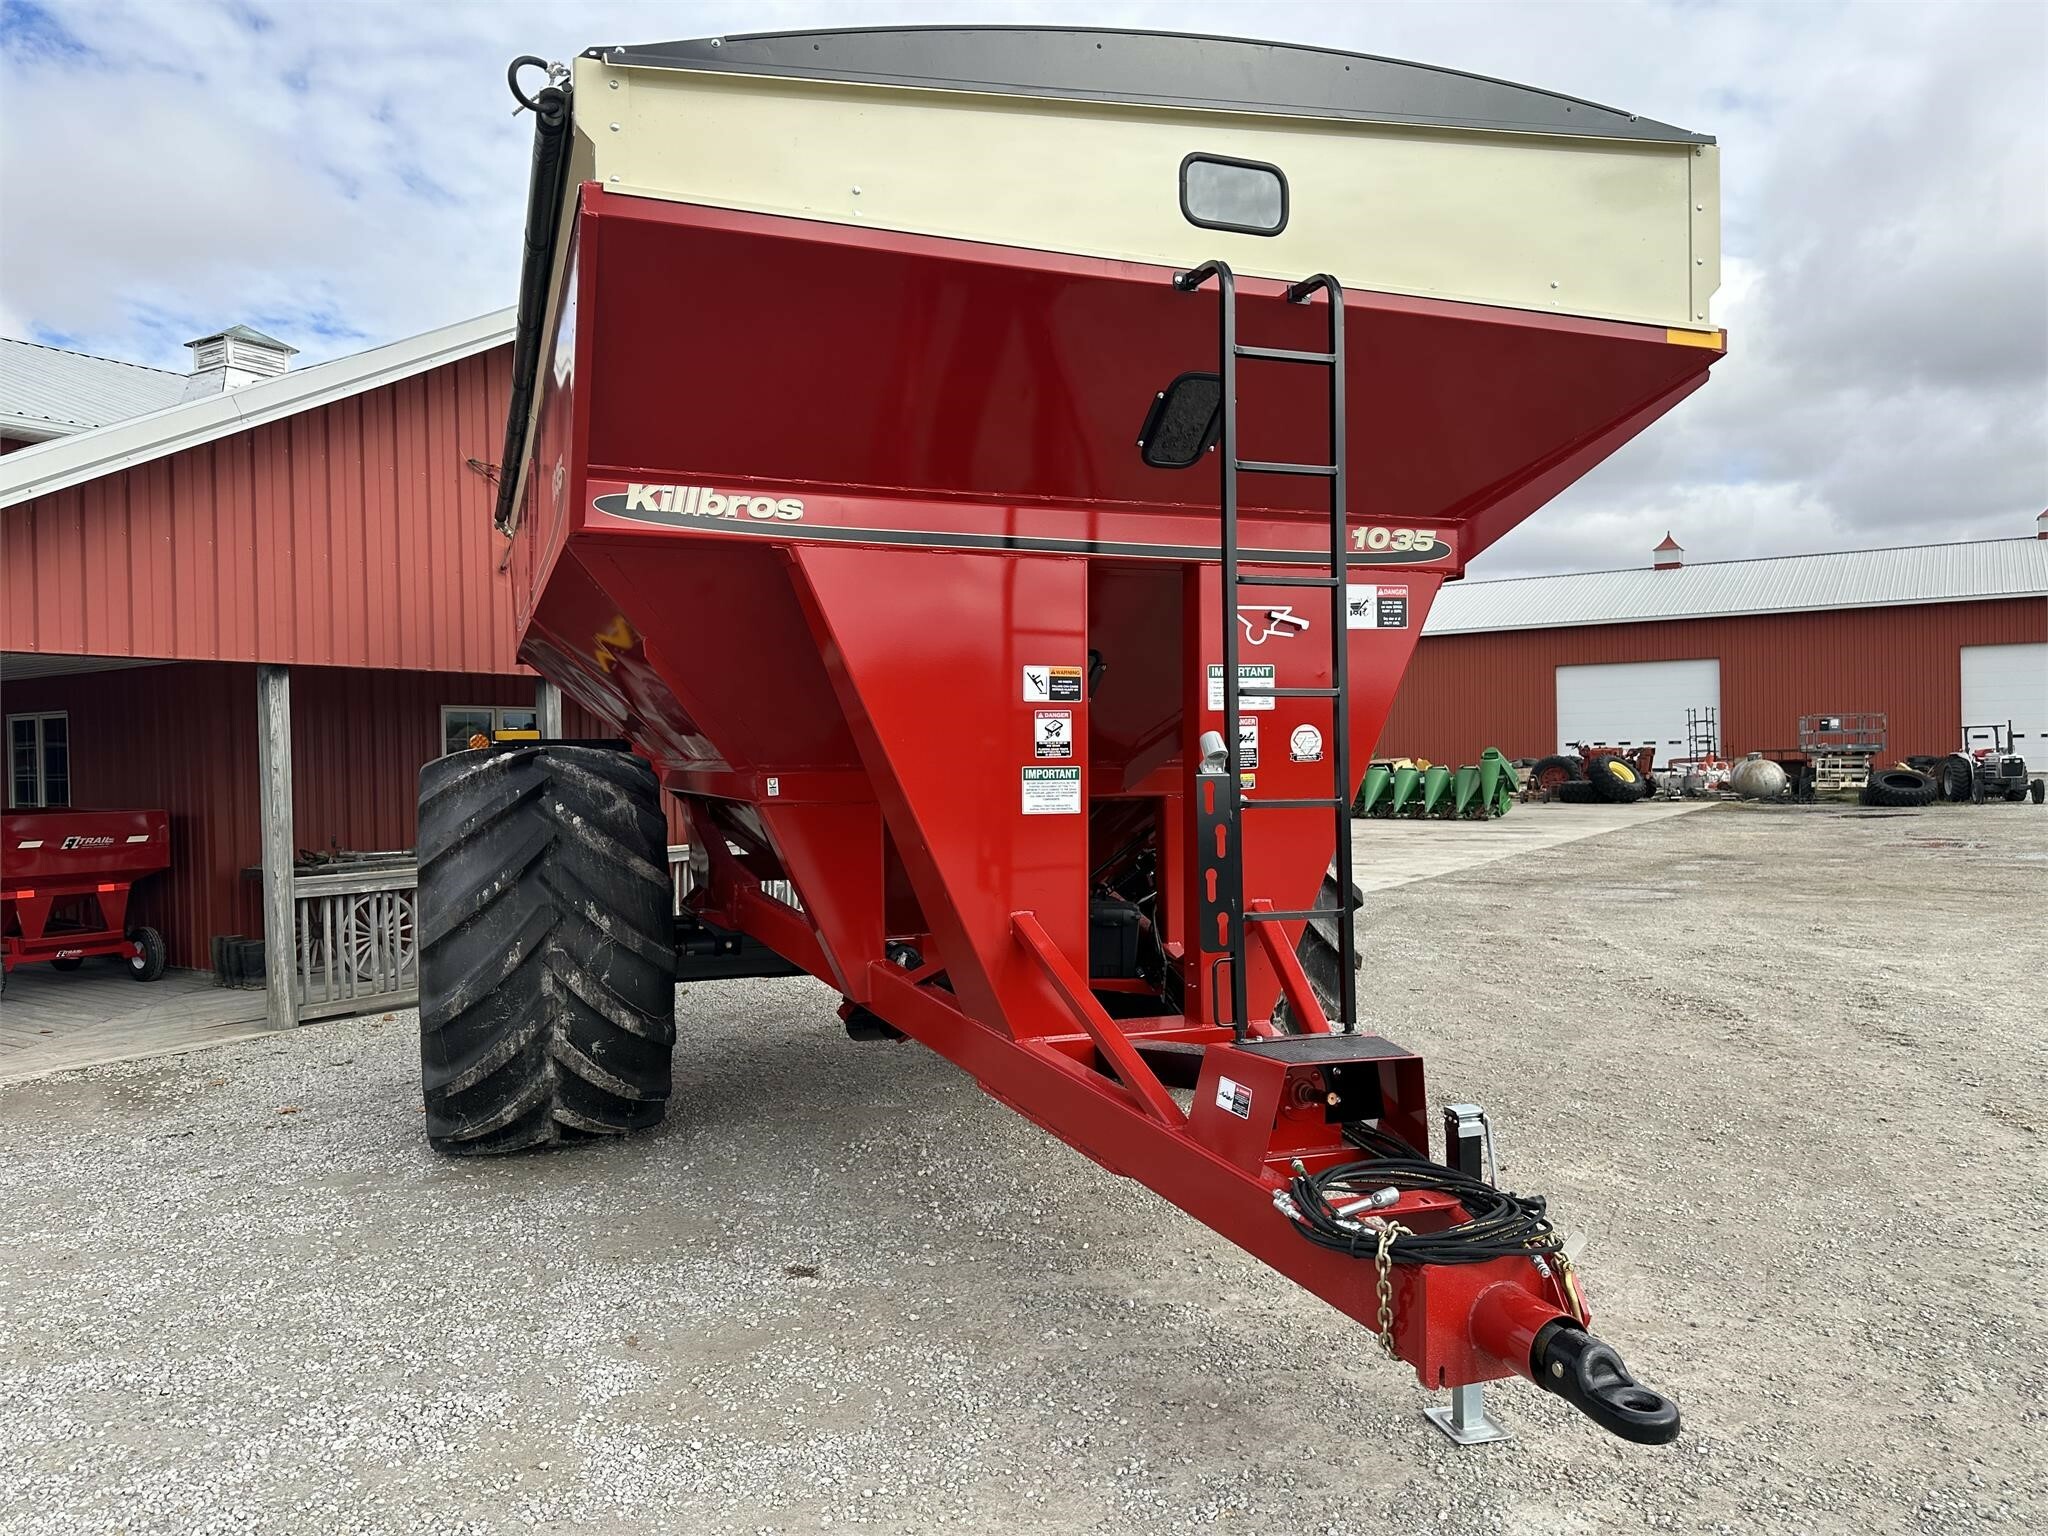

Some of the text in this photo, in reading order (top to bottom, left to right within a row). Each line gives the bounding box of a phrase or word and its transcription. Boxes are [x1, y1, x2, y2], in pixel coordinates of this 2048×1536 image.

[625, 483, 804, 520] Killbros
[1351, 526, 1437, 552] 1035
[1383, 588, 1407, 596] DANGER
[1211, 667, 1271, 677] IMRTANT
[1025, 769, 1078, 779] IMPORTANT
